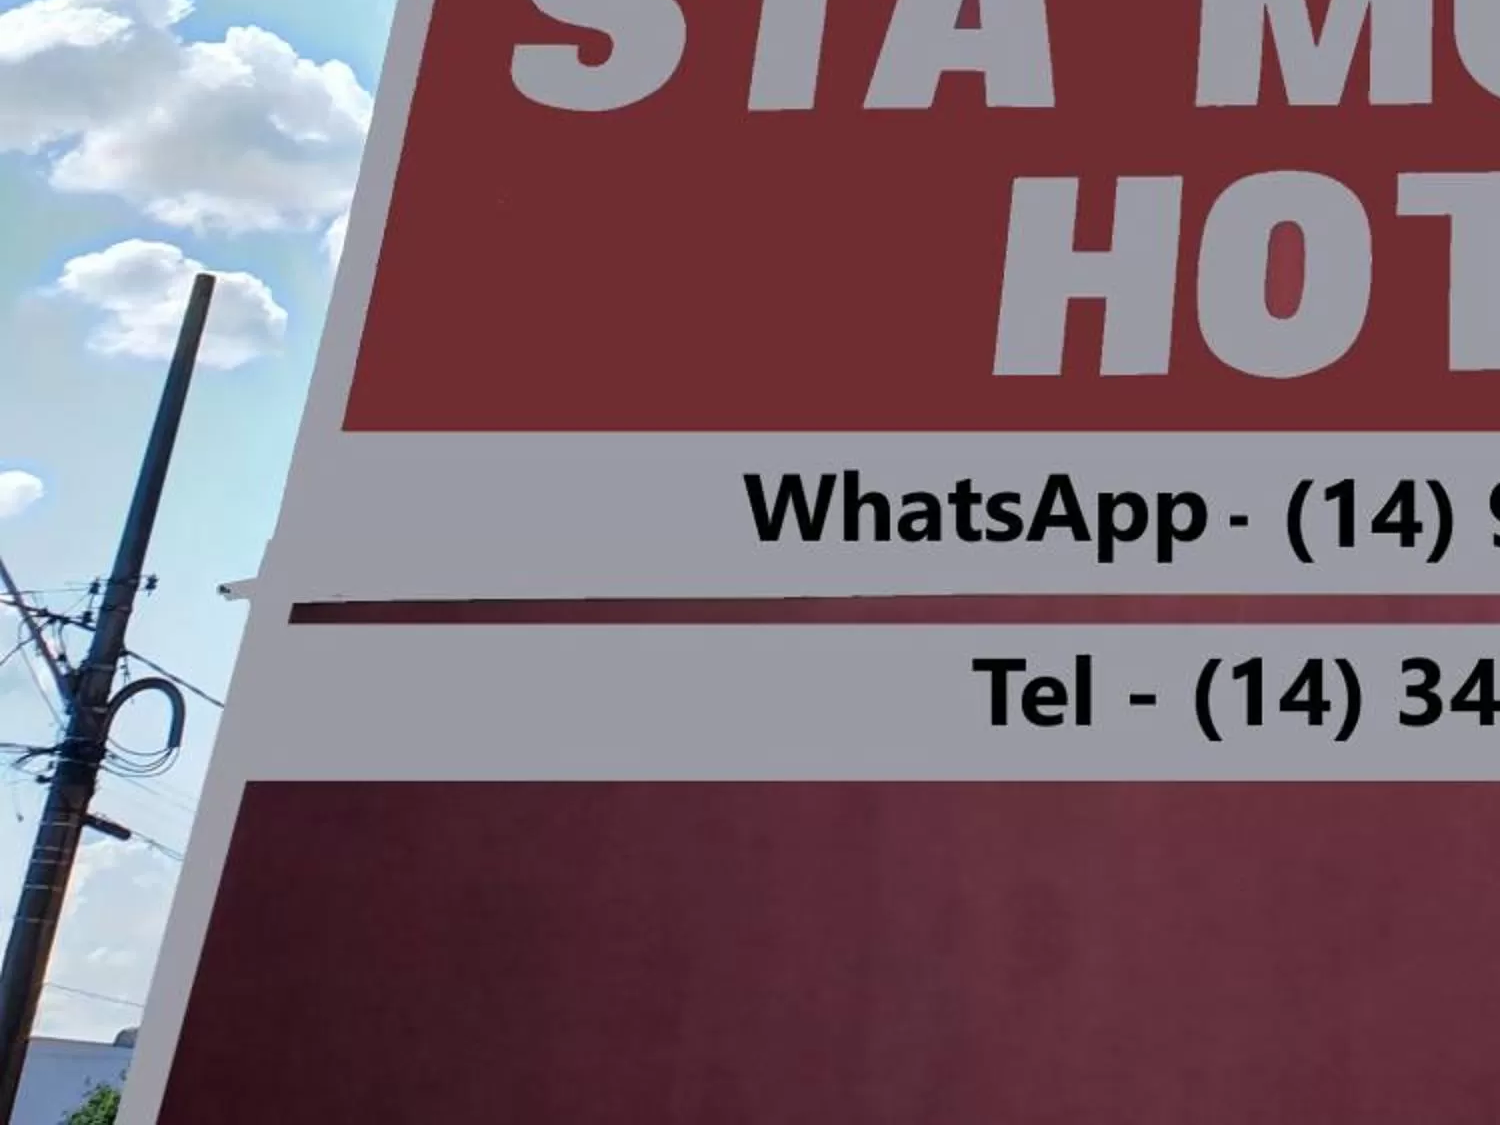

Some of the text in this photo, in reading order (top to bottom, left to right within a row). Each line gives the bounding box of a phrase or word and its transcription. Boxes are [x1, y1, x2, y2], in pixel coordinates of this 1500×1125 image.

[743, 470, 1208, 564] WhatsApp
[1287, 478, 1453, 564] (14)
[971, 654, 1092, 727] Tel
[1195, 657, 1362, 742] (14)
